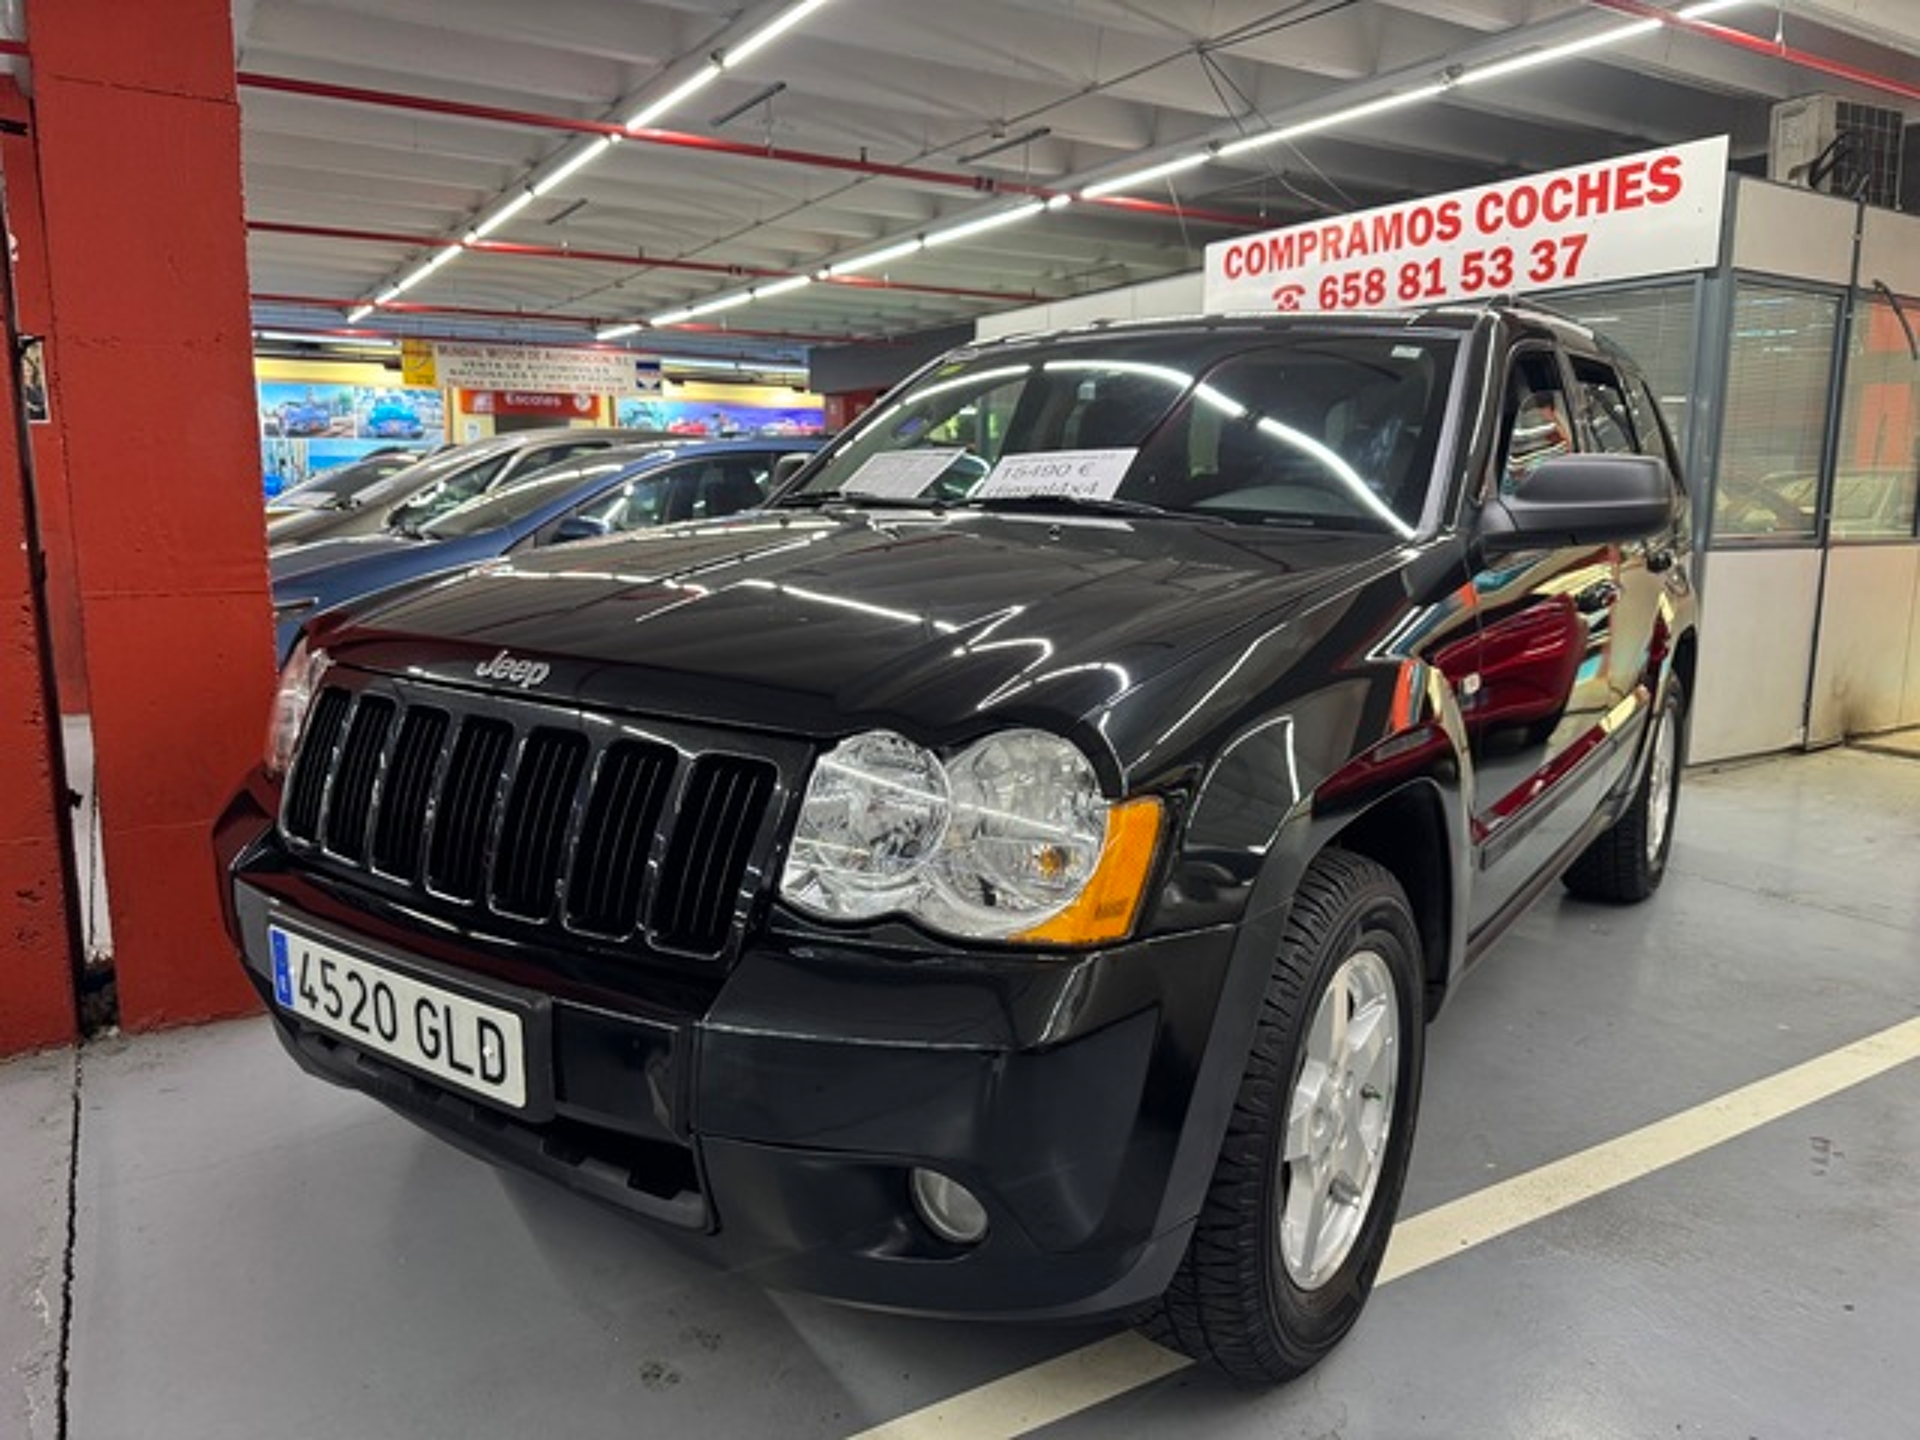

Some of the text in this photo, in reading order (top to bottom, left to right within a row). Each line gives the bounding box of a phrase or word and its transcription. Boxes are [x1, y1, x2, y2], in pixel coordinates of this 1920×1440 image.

[1223, 155, 1682, 279] COMPRAMOS COCHES
[1318, 234, 1588, 310] 658 81 53 37
[475, 649, 550, 688] Jeep
[299, 952, 506, 1085] 4520 GLD
